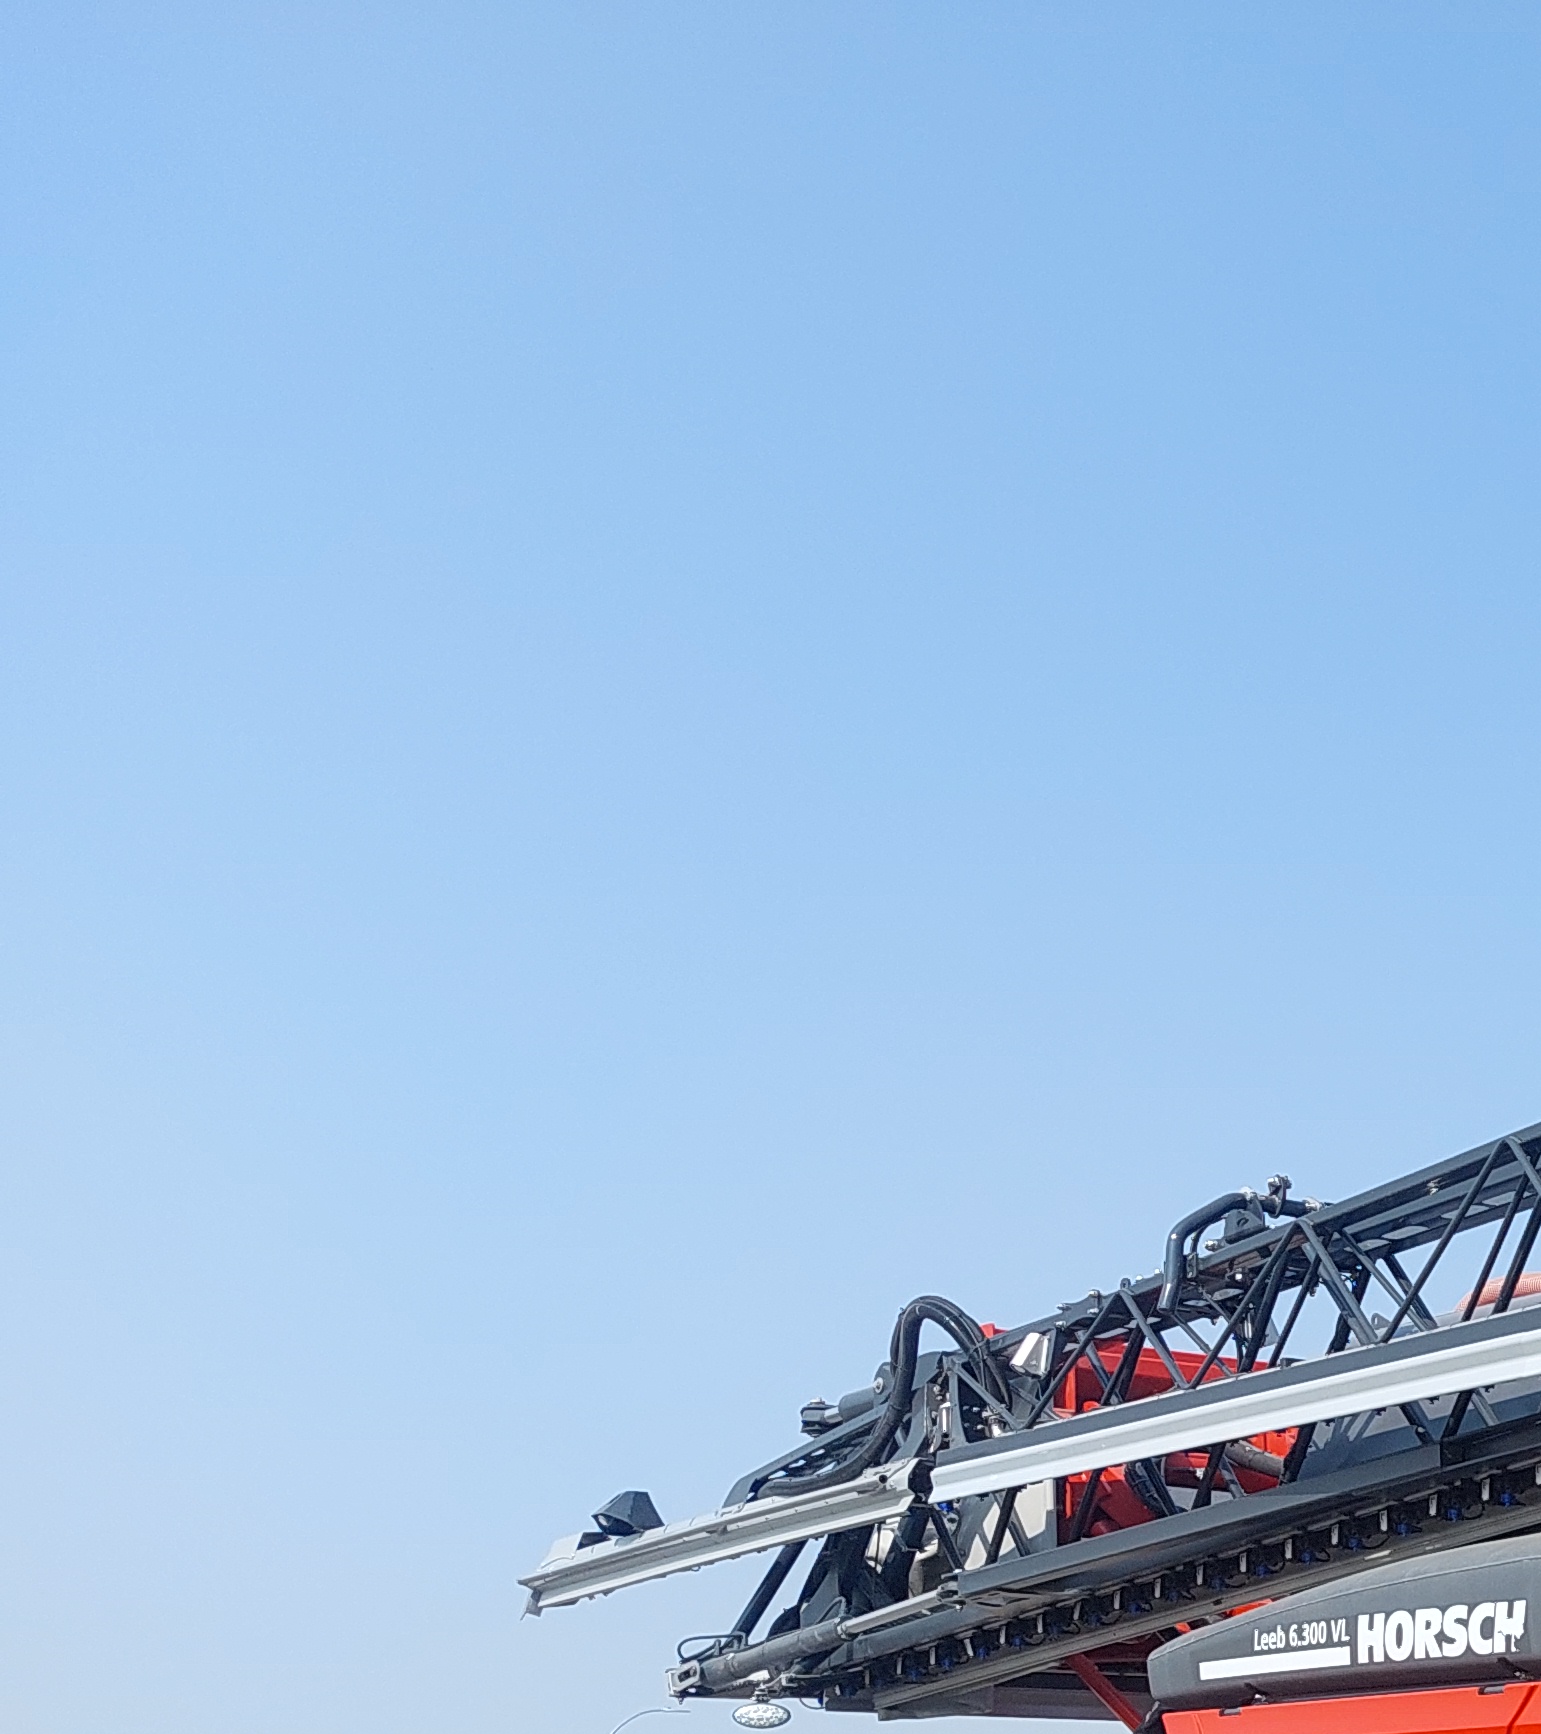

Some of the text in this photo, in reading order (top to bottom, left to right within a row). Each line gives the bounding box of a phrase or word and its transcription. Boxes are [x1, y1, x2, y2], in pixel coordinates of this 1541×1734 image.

[1254, 1617, 1351, 1651] Leeb 6.300 VL
[1357, 1600, 1527, 1664] HORSCH
